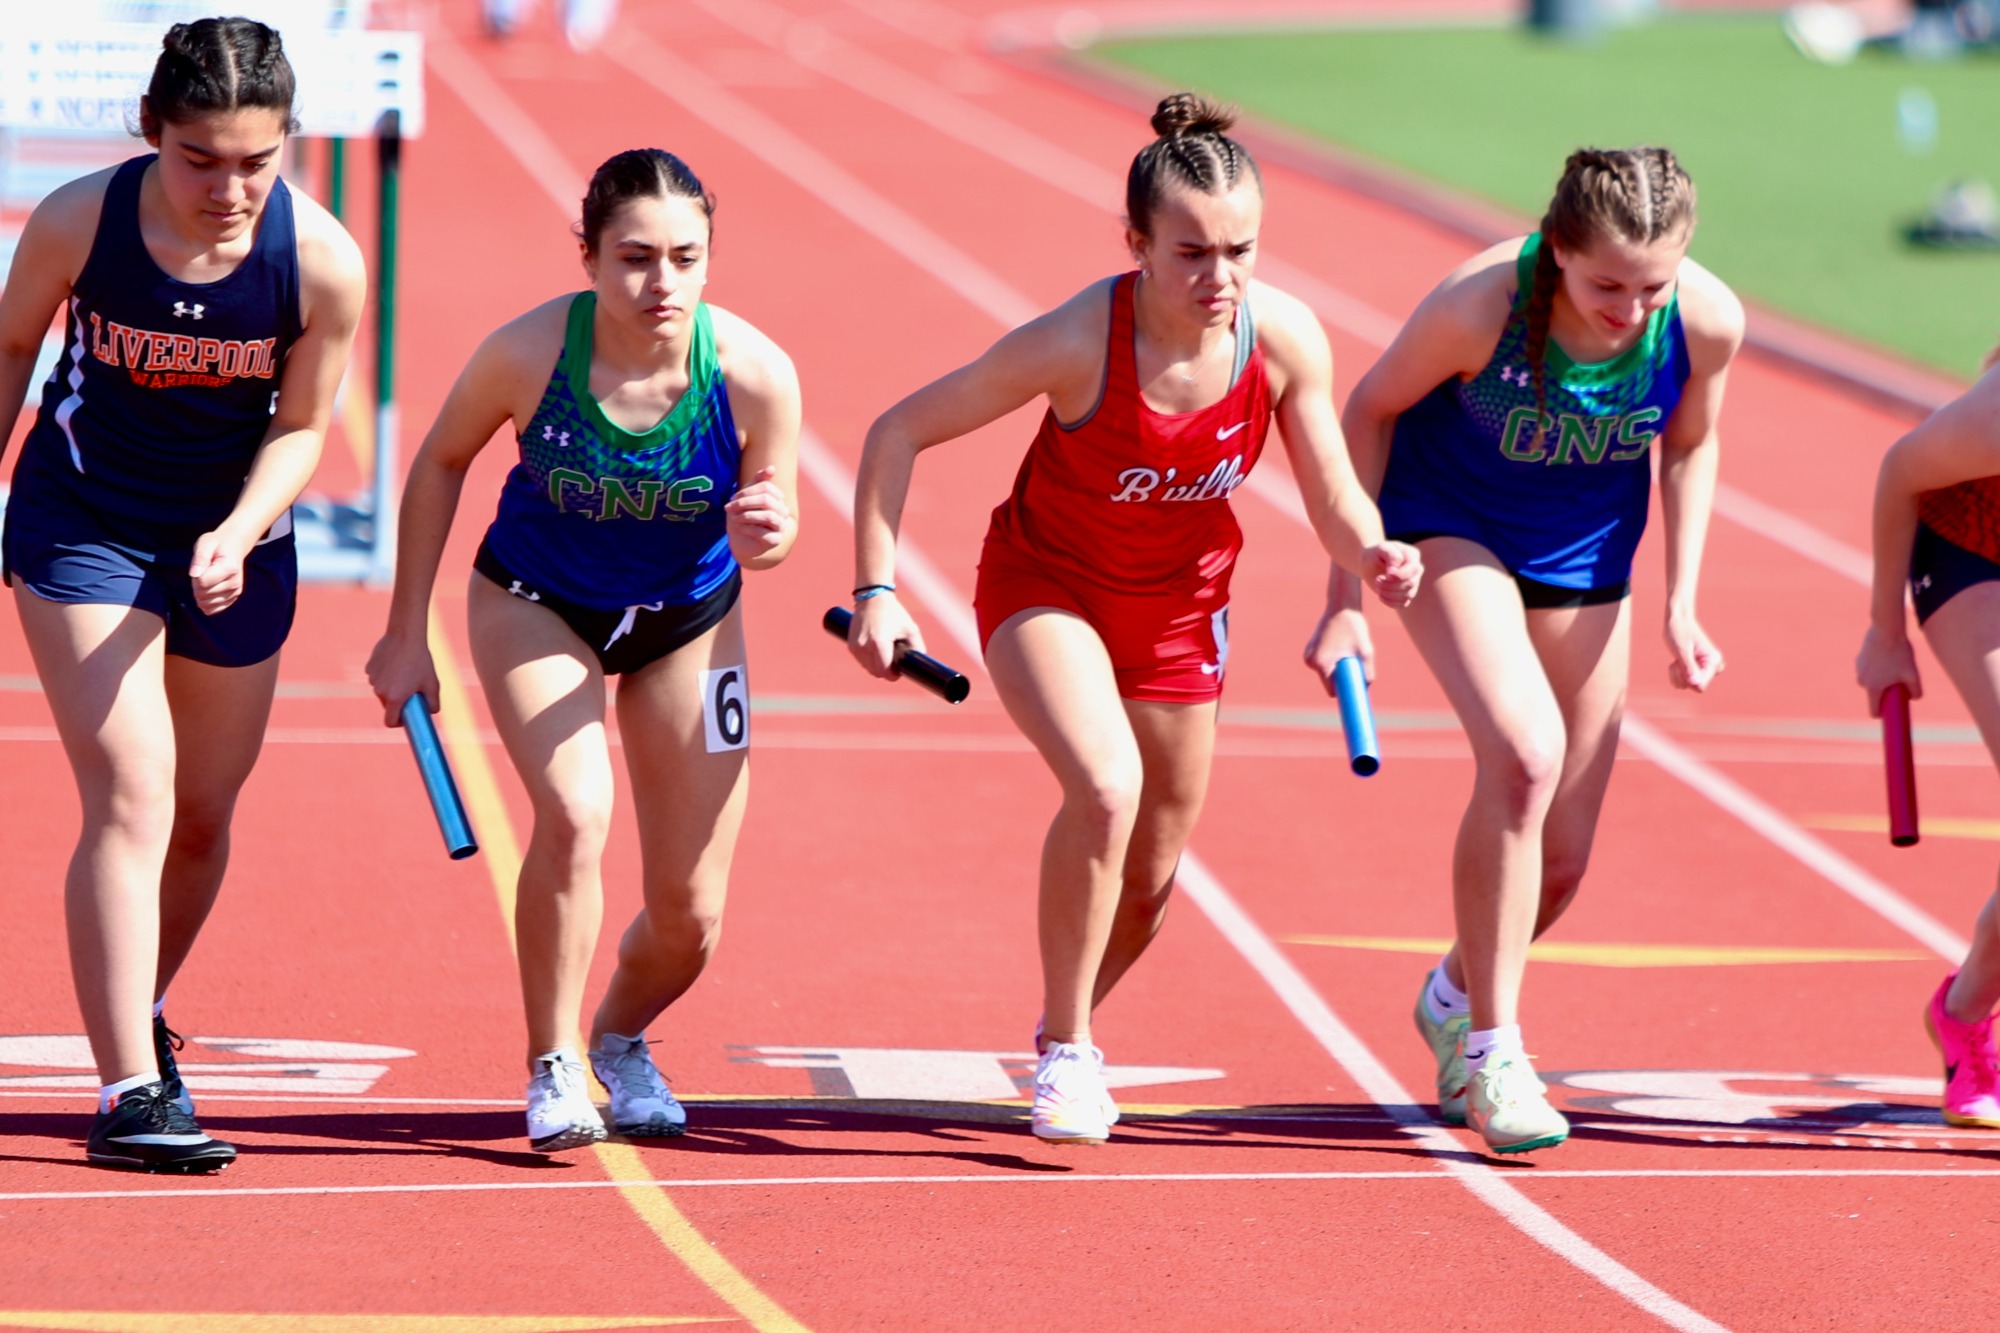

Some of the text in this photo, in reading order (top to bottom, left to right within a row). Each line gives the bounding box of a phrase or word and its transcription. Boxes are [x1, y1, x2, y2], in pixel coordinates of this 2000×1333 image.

[90, 311, 277, 379] LIVERPOOL
[129, 369, 235, 389] WARRIORS
[1499, 406, 1663, 466] CNS
[549, 467, 714, 523] CNS
[715, 670, 745, 746] 6
